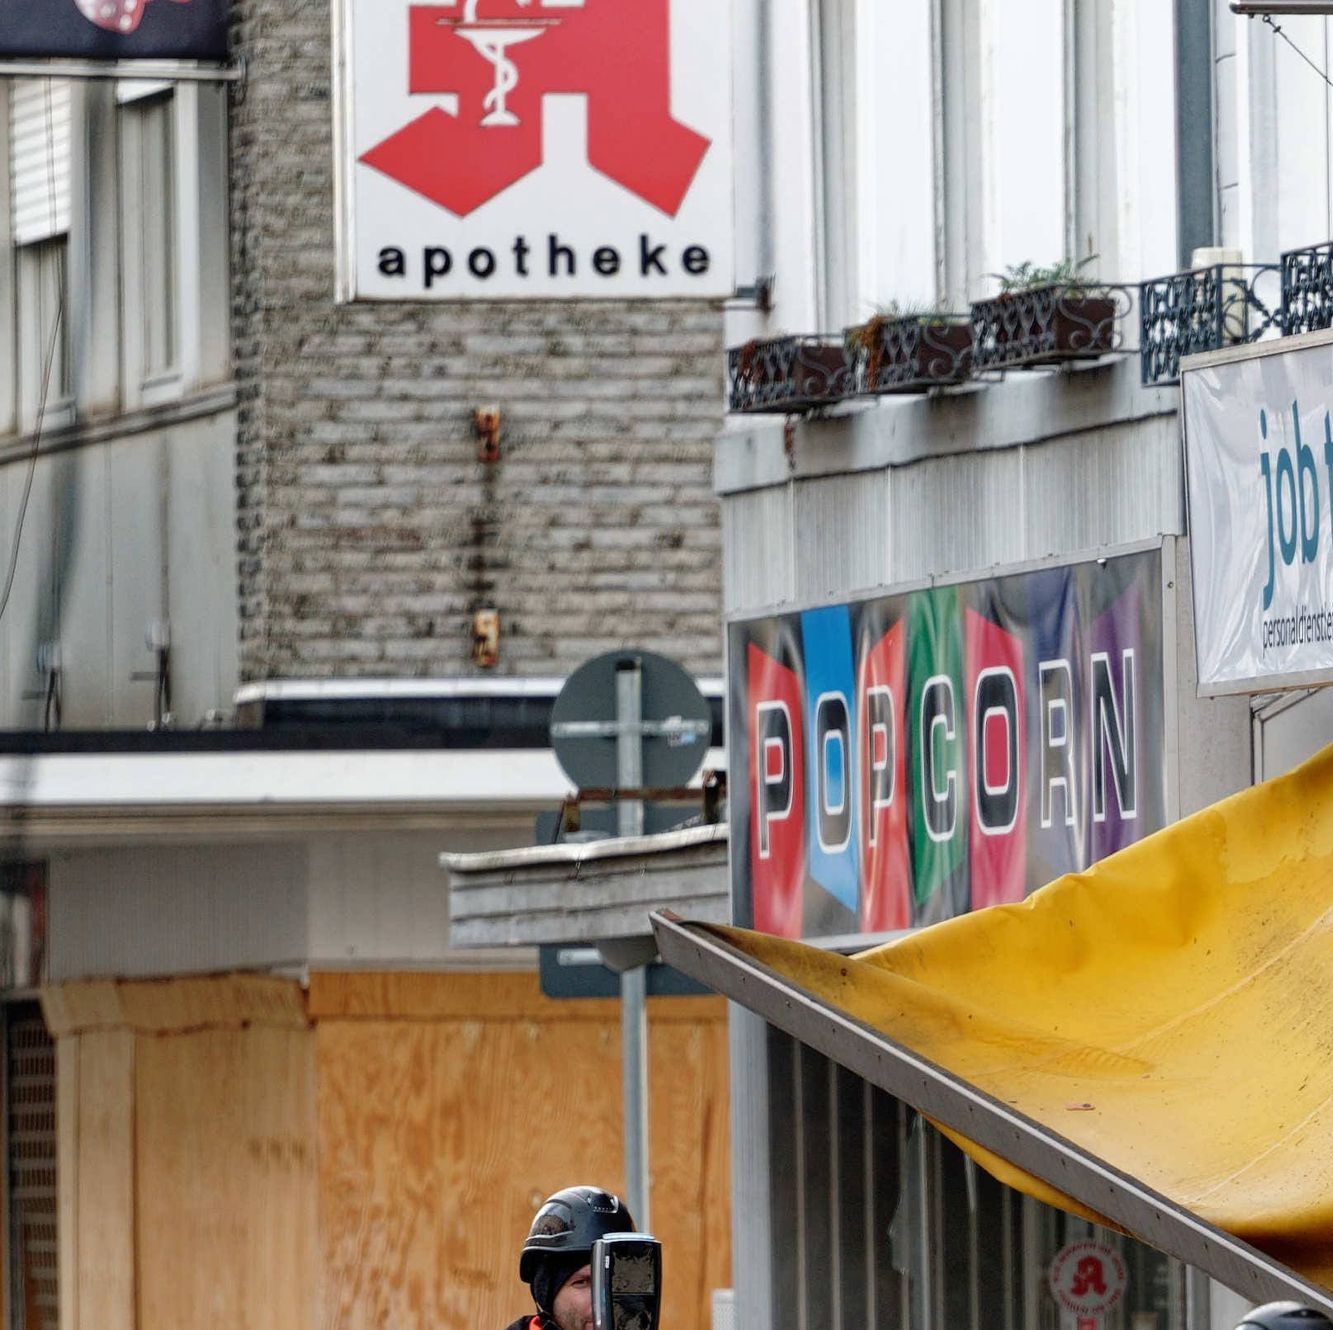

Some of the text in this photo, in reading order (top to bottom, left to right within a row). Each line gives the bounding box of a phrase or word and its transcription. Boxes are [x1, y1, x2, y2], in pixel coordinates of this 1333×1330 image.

[378, 234, 711, 289] apotheke
[1260, 399, 1320, 611] job
[756, 647, 1140, 860] POPCORN
